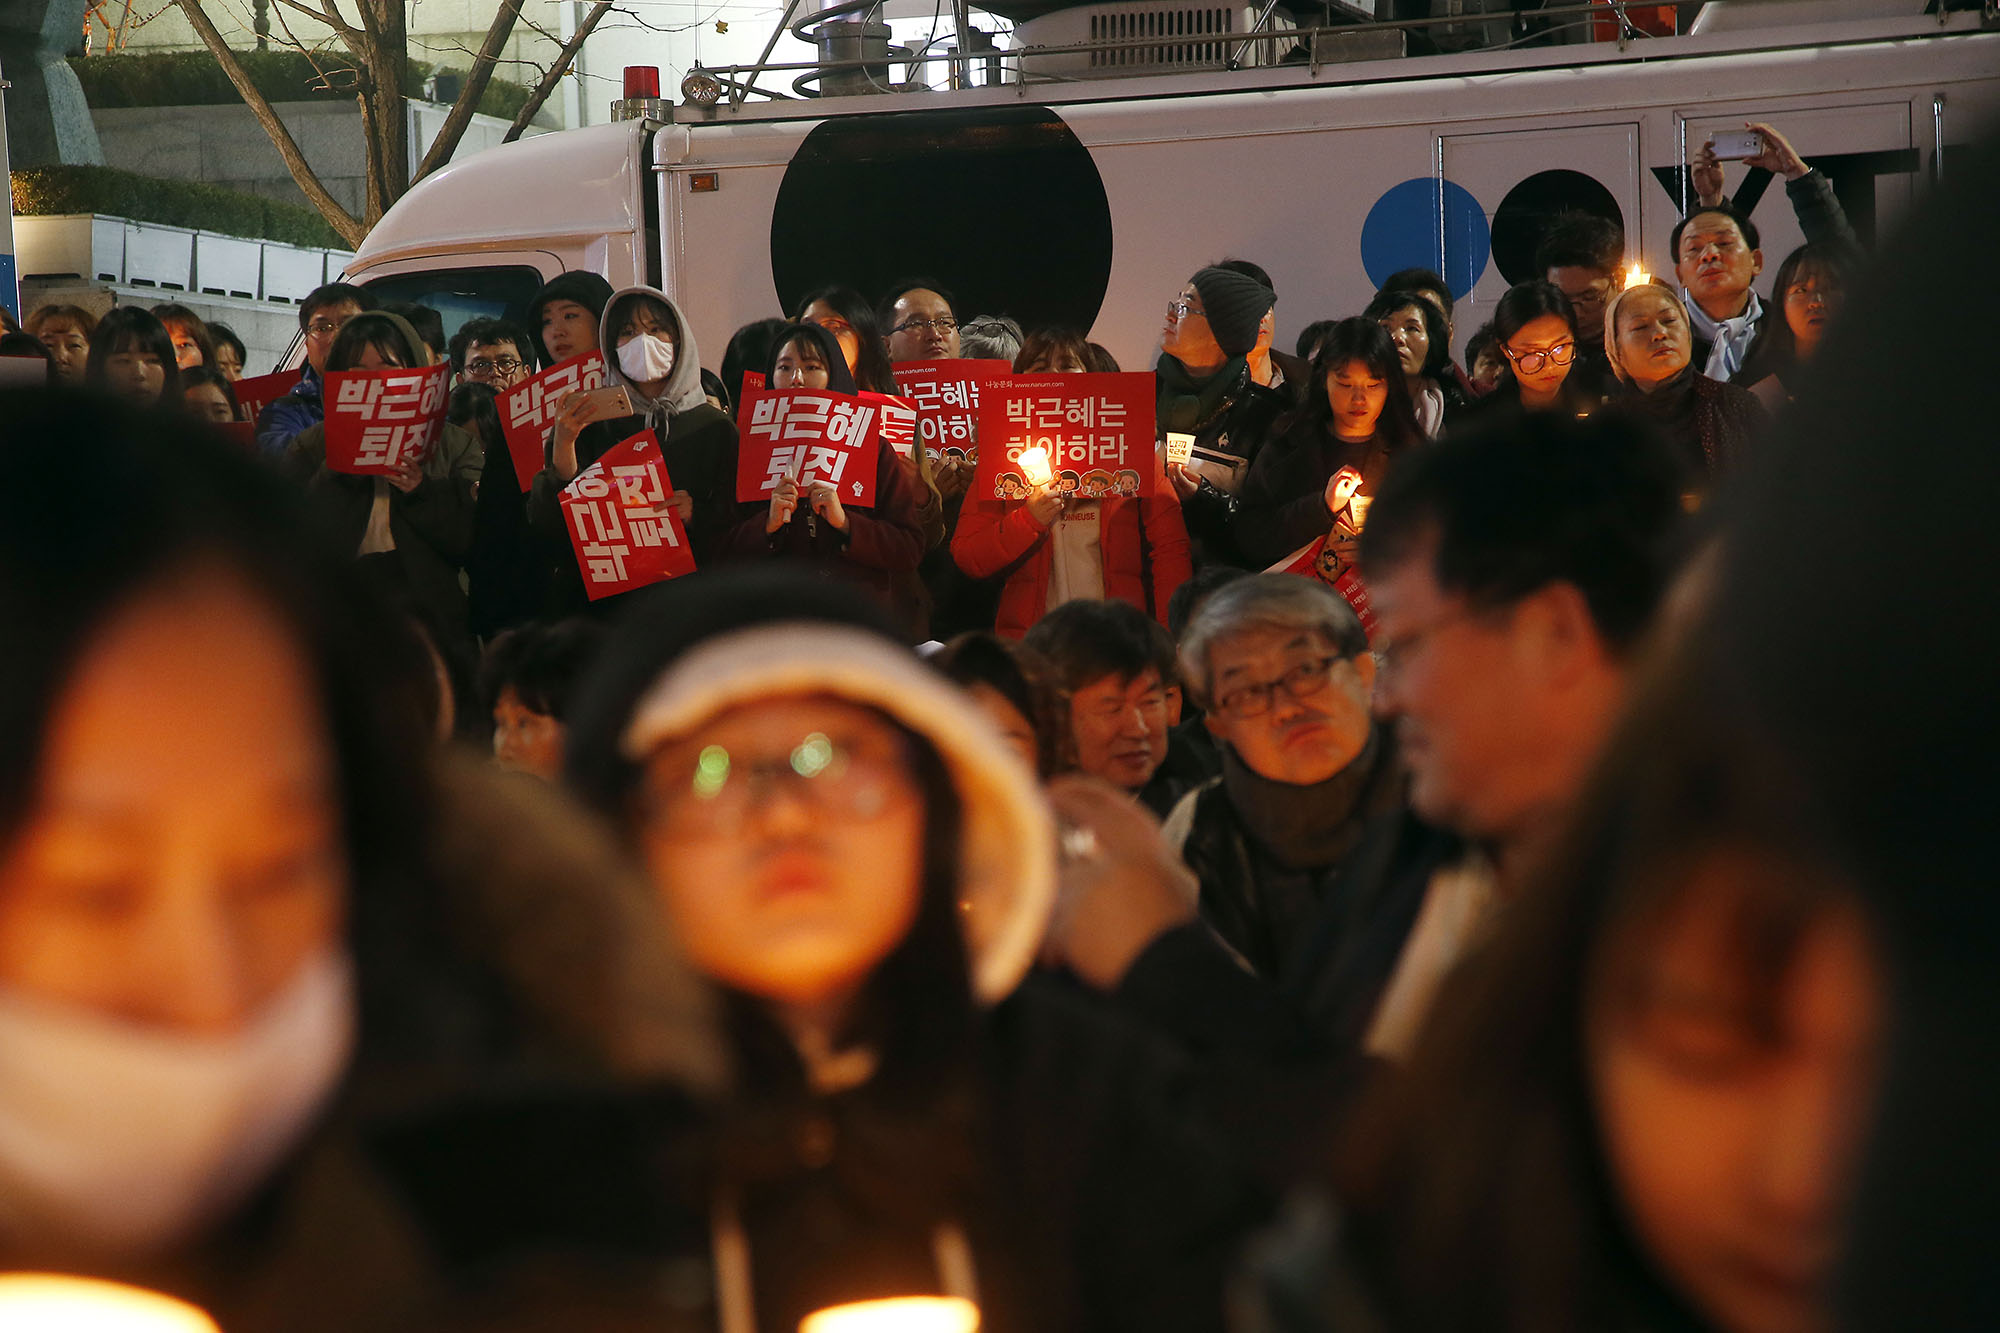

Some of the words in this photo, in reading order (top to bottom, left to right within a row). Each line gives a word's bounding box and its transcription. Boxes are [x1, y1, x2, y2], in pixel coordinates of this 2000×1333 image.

[336, 369, 449, 420] 박근혜
[1014, 381, 1065, 389] www.nanum.com
[749, 396, 875, 448] 박근혜
[1006, 396, 1127, 429] 박근혜는
[353, 419, 435, 466] 퇴진
[1005, 433, 1129, 466] 하야하라
[760, 445, 849, 491] 퇴진
[611, 463, 680, 548] 퇴진
